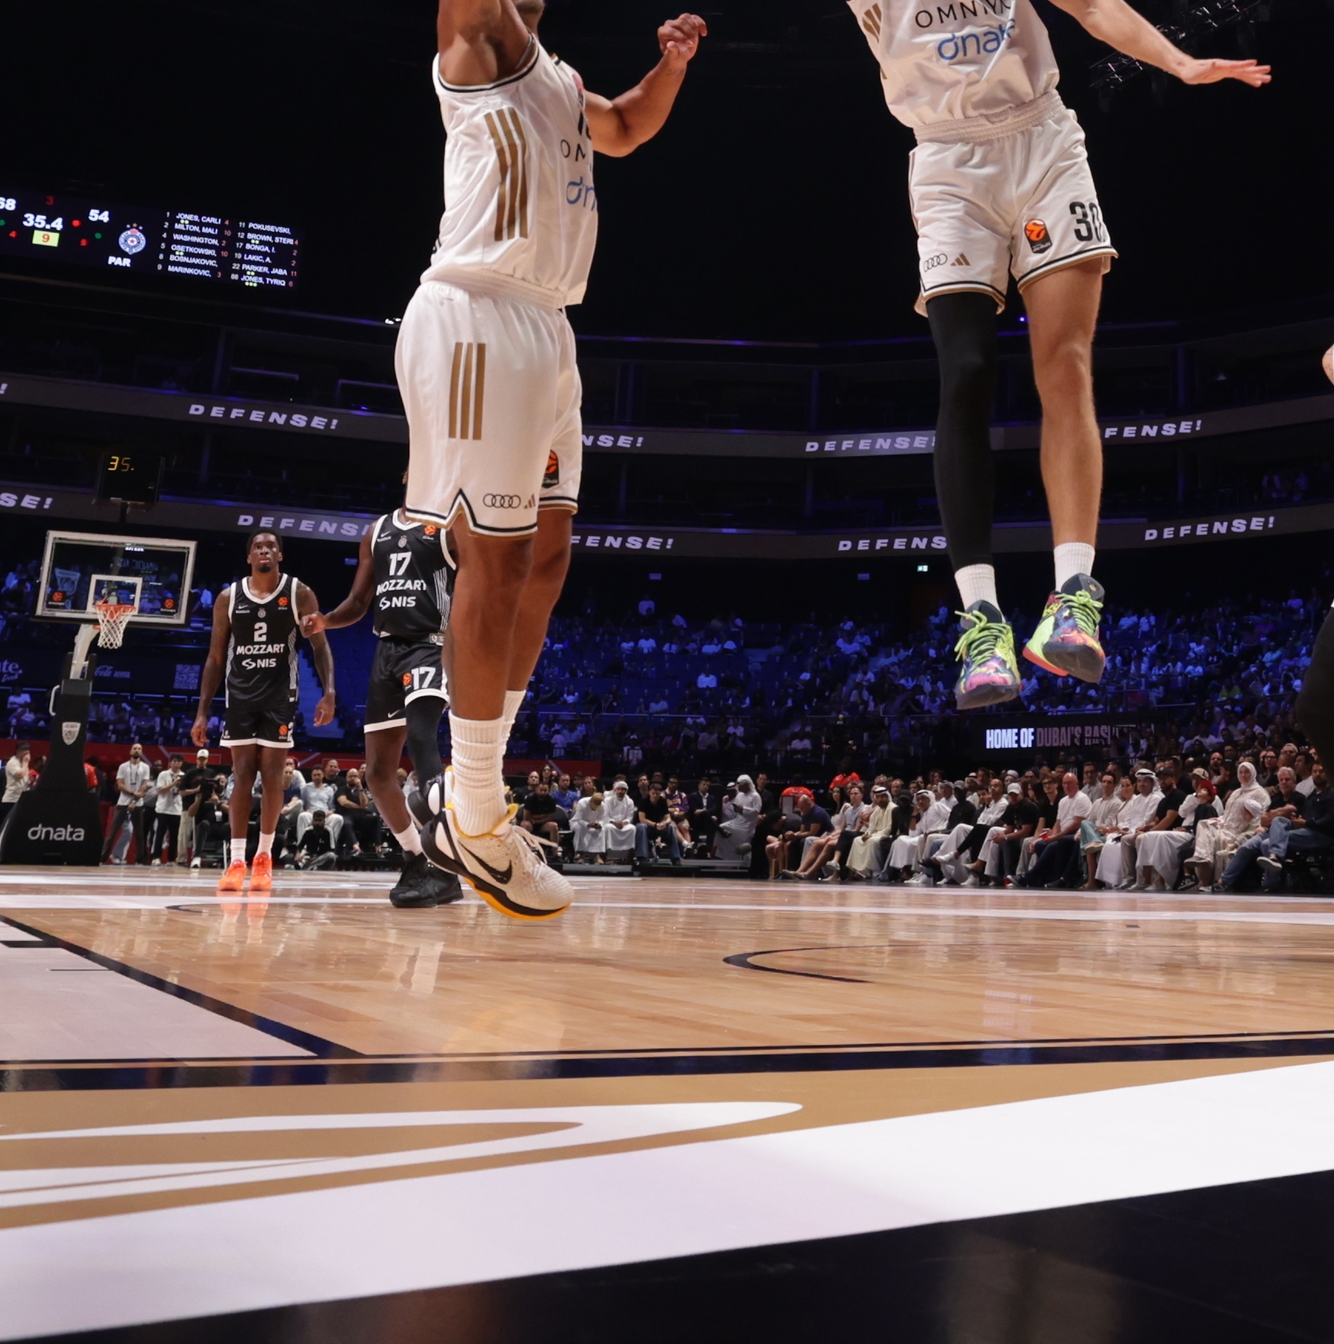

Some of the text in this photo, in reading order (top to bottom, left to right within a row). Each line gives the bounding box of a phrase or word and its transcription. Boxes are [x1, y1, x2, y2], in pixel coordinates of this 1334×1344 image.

[23, 213, 63, 230] 35.4
[89, 209, 109, 223] 54
[1069, 201, 1106, 243] 30
[42, 234, 50, 243] 9
[108, 256, 131, 267] PAR
[188, 404, 340, 431] DEFENSE!
[1144, 516, 1275, 541] DEFENSE!
[389, 551, 412, 577] 17
[391, 596, 416, 608] NIS
[253, 621, 268, 642] 2
[236, 643, 285, 656] MOZZART
[256, 658, 277, 668] NIS
[411, 666, 436, 690] 17
[986, 728, 1018, 749] HOME
[1020, 728, 1035, 747] OF
[1036, 726, 1082, 747] DUBAI'S
[27, 823, 85, 841] dnata
